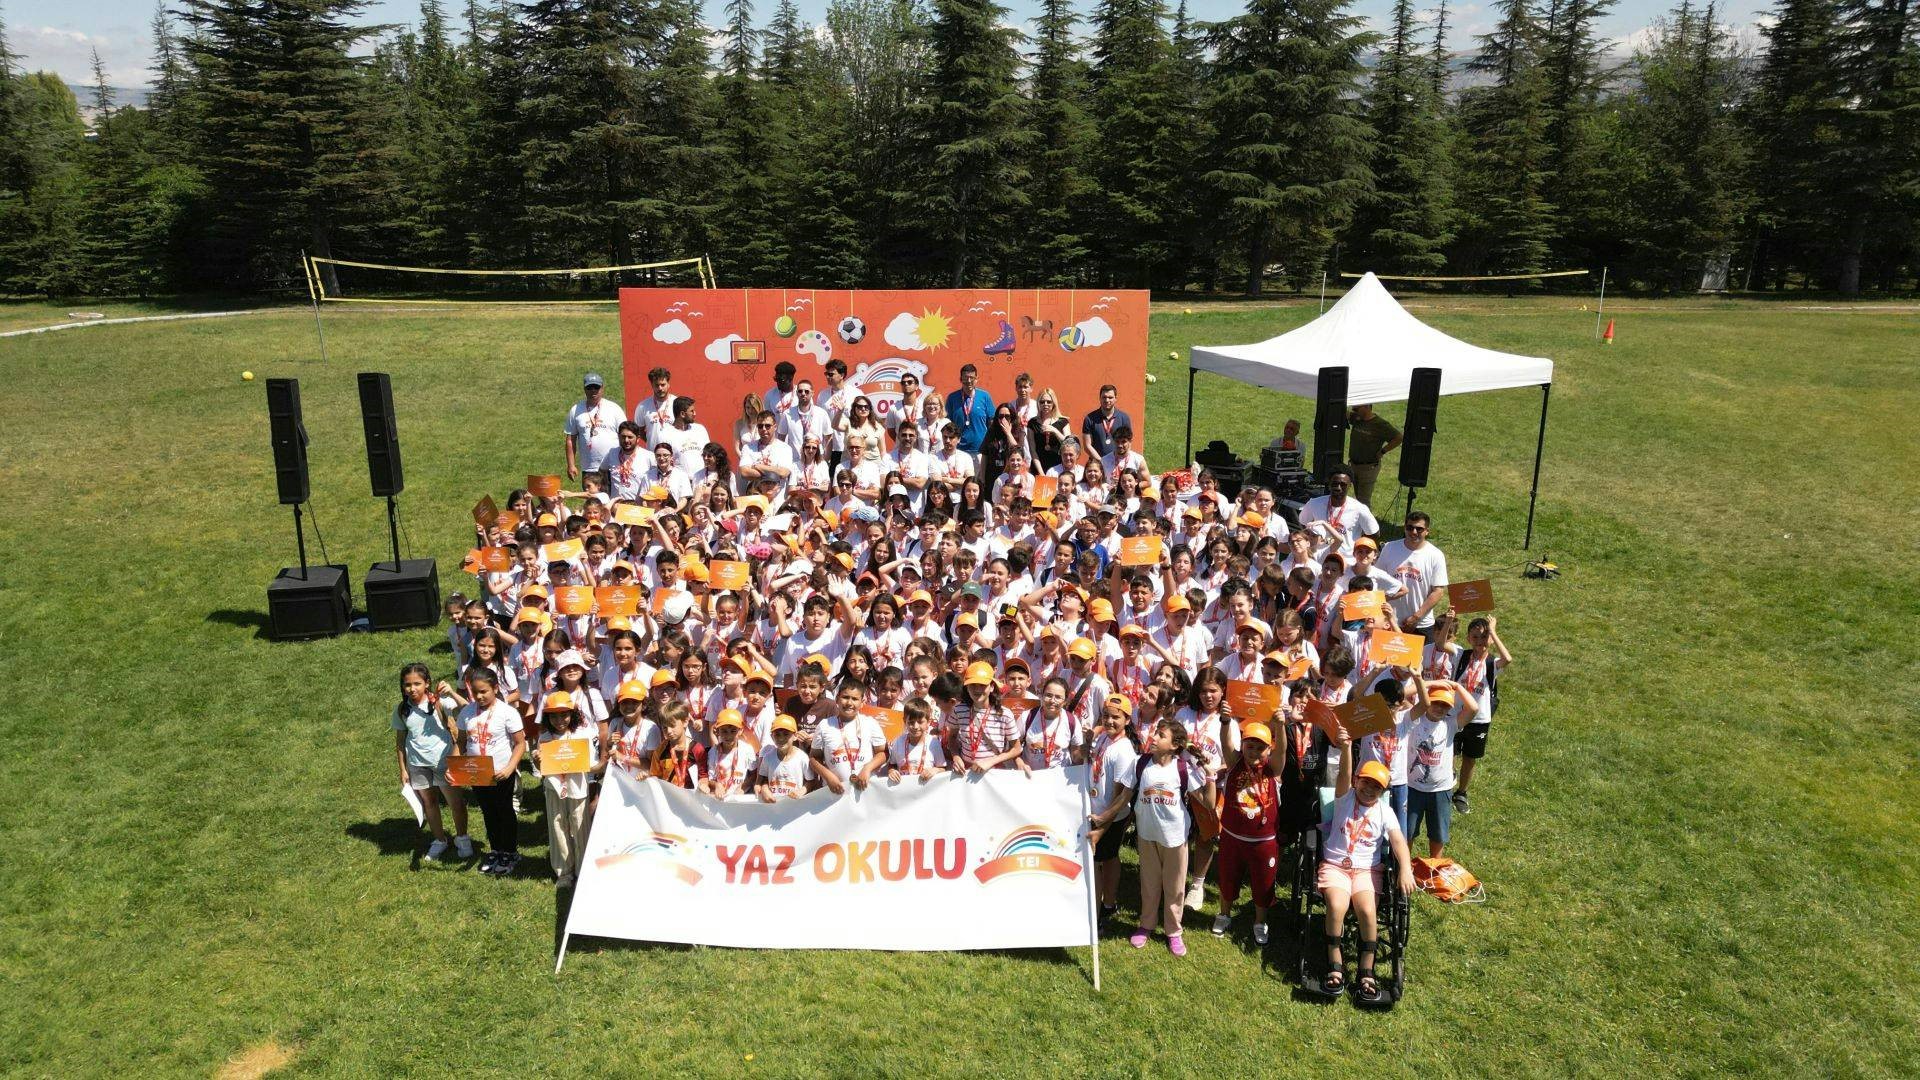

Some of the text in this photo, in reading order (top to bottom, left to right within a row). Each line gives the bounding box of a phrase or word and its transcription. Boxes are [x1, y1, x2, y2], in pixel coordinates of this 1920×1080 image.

[878, 382, 894, 390] TEI
[716, 838, 967, 885] YAZ OKULU
[1016, 856, 1040, 868] TEI
